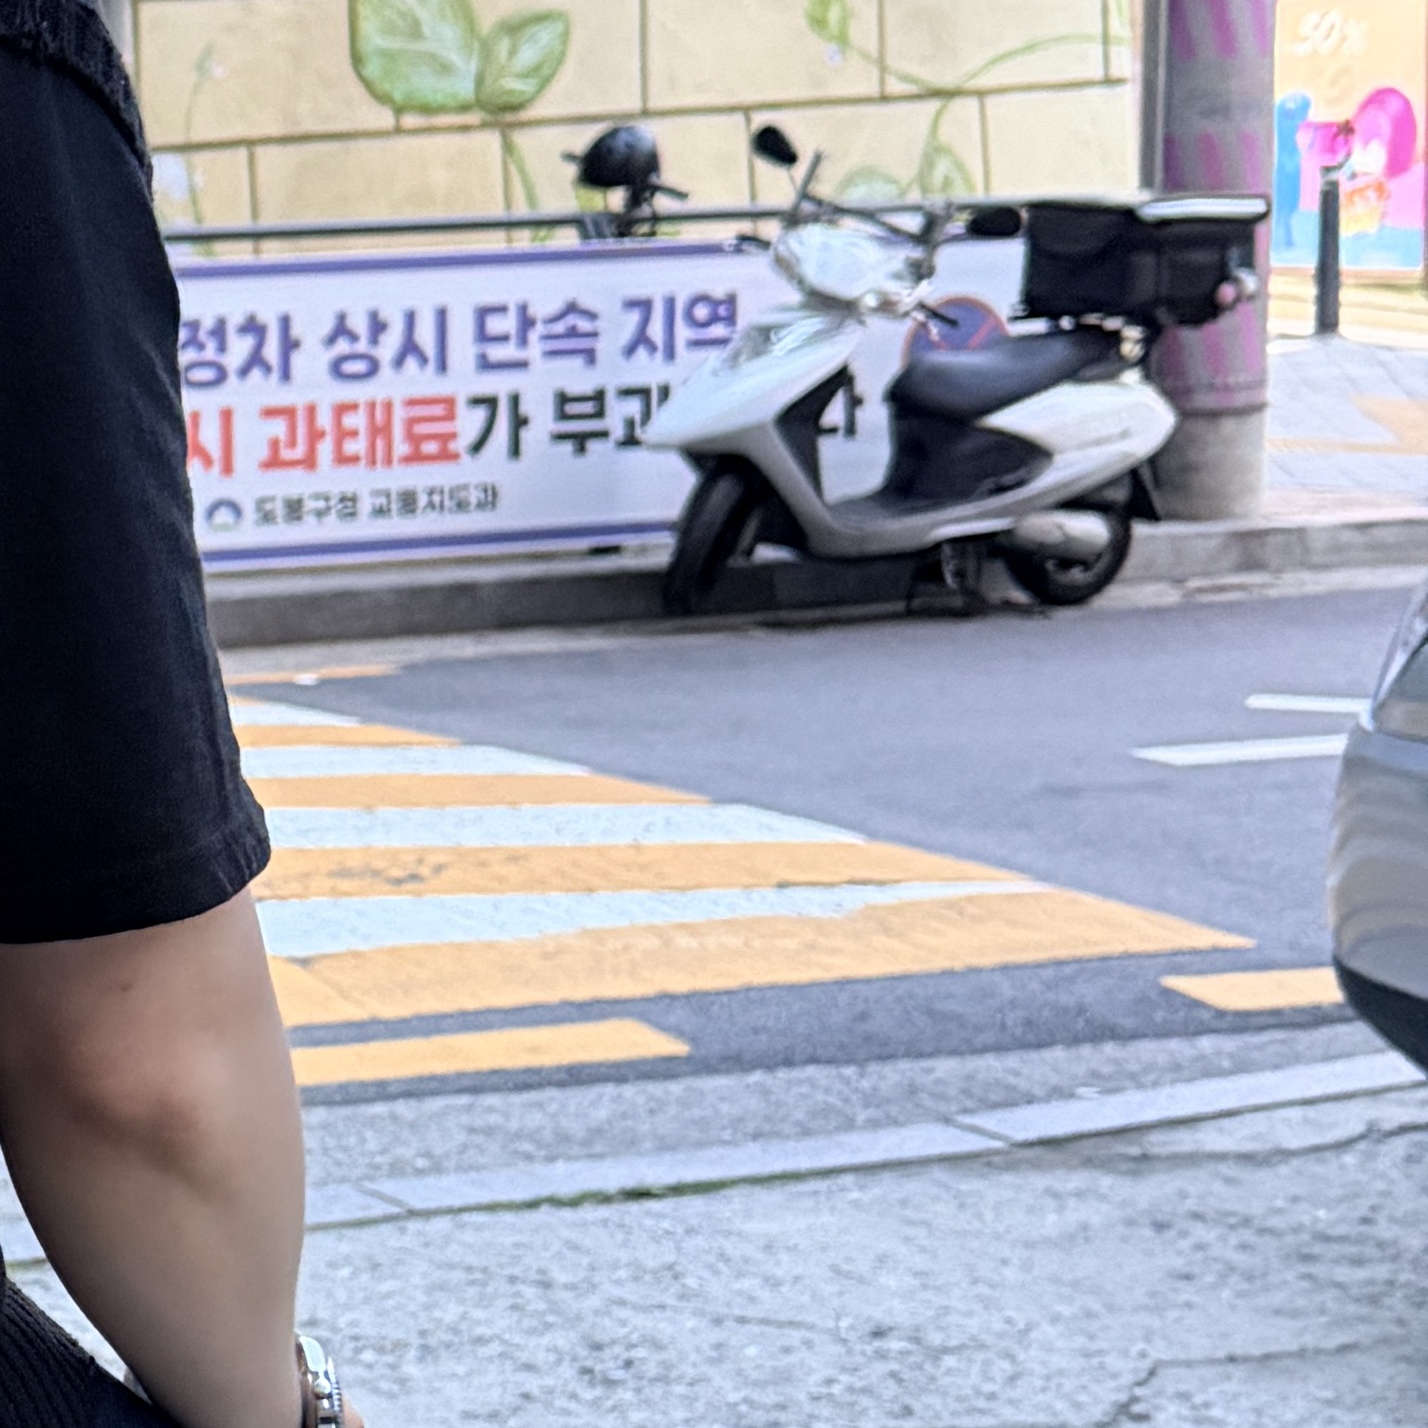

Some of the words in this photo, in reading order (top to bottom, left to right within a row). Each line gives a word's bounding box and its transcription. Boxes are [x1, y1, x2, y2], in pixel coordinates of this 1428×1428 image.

[323, 305, 448, 380] 상시
[474, 300, 600, 374] 단속
[621, 292, 738, 361] 지역
[259, 393, 529, 472] 과태료가
